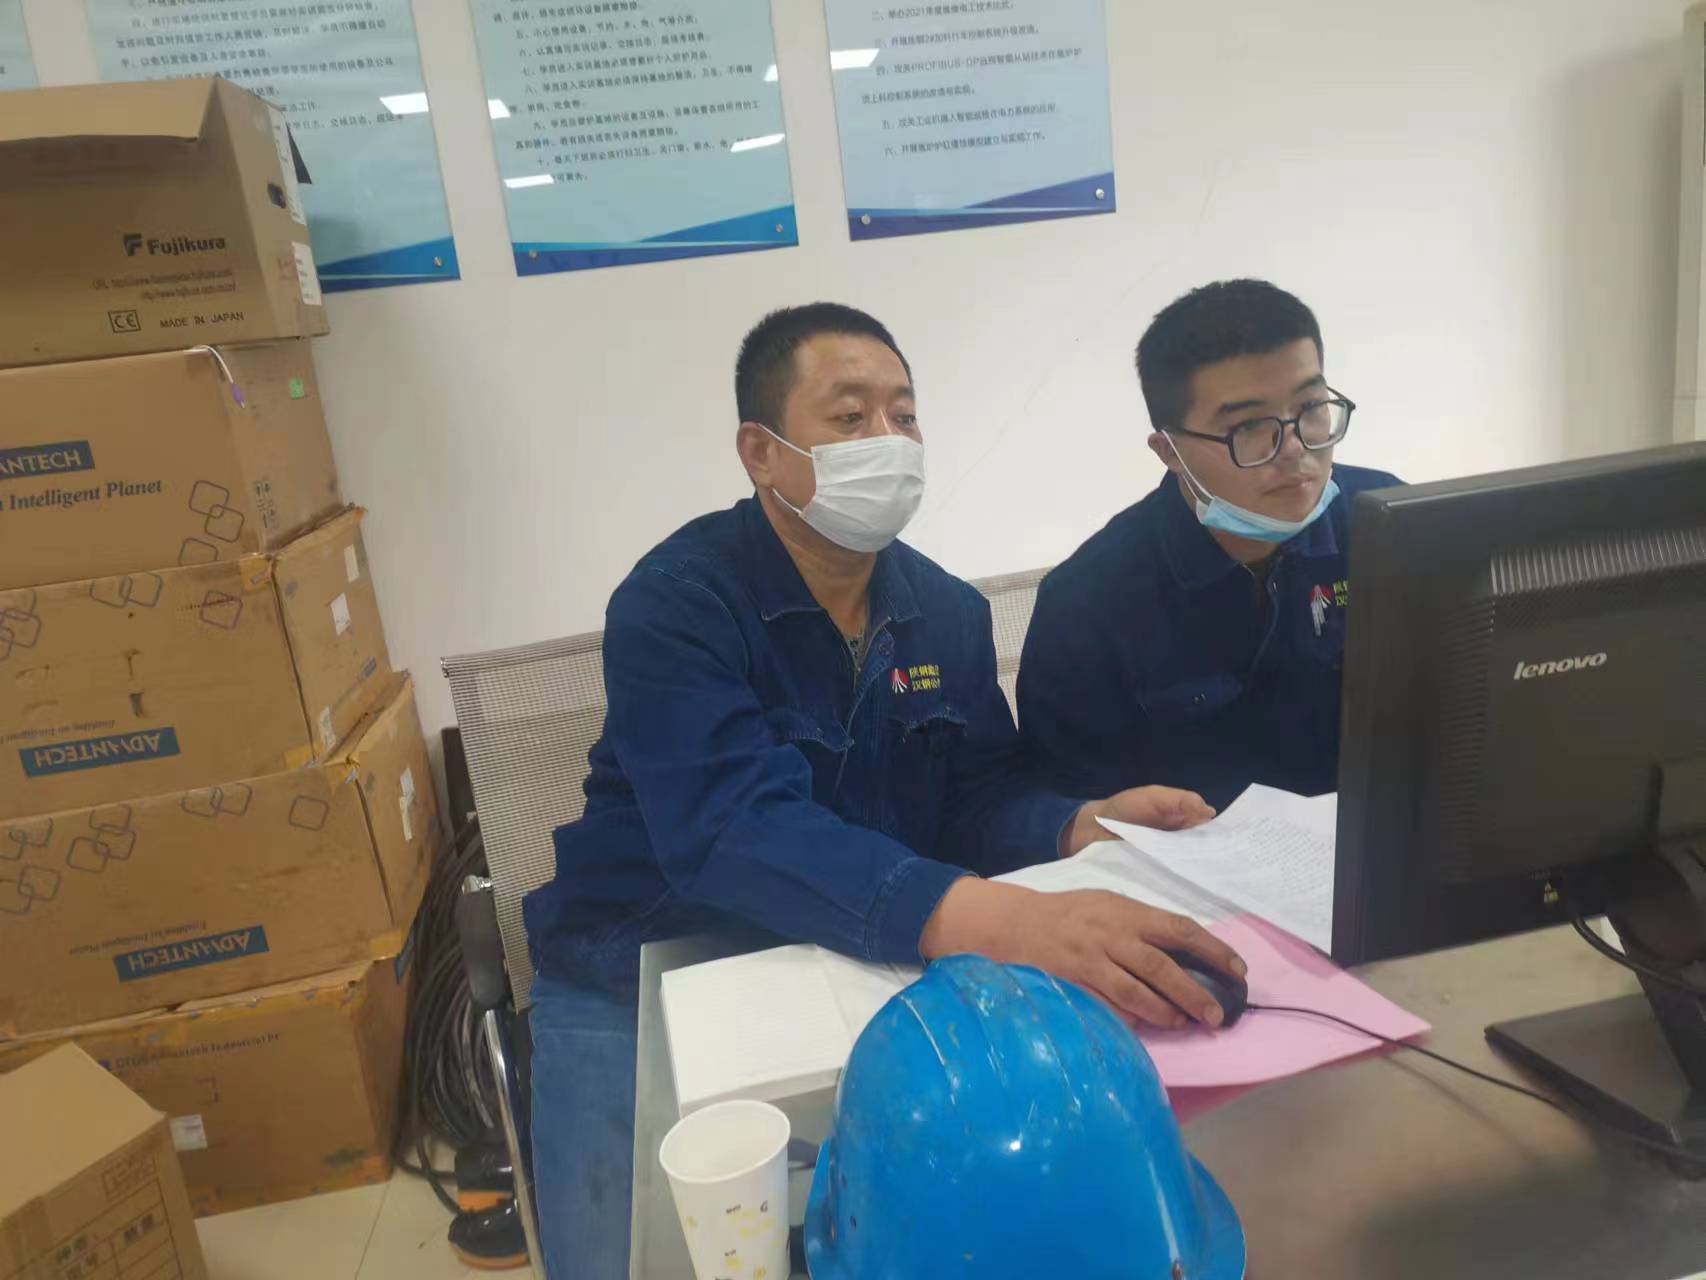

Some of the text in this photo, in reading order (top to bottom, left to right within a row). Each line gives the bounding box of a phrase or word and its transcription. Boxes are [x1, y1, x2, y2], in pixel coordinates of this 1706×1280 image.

[147, 236, 226, 256] Fujikura
[159, 311, 245, 329] MADE IN JAPAN
[9, 487, 101, 511] Intelligent
[106, 479, 162, 499] Planet
[1513, 652, 1608, 681] lenovo
